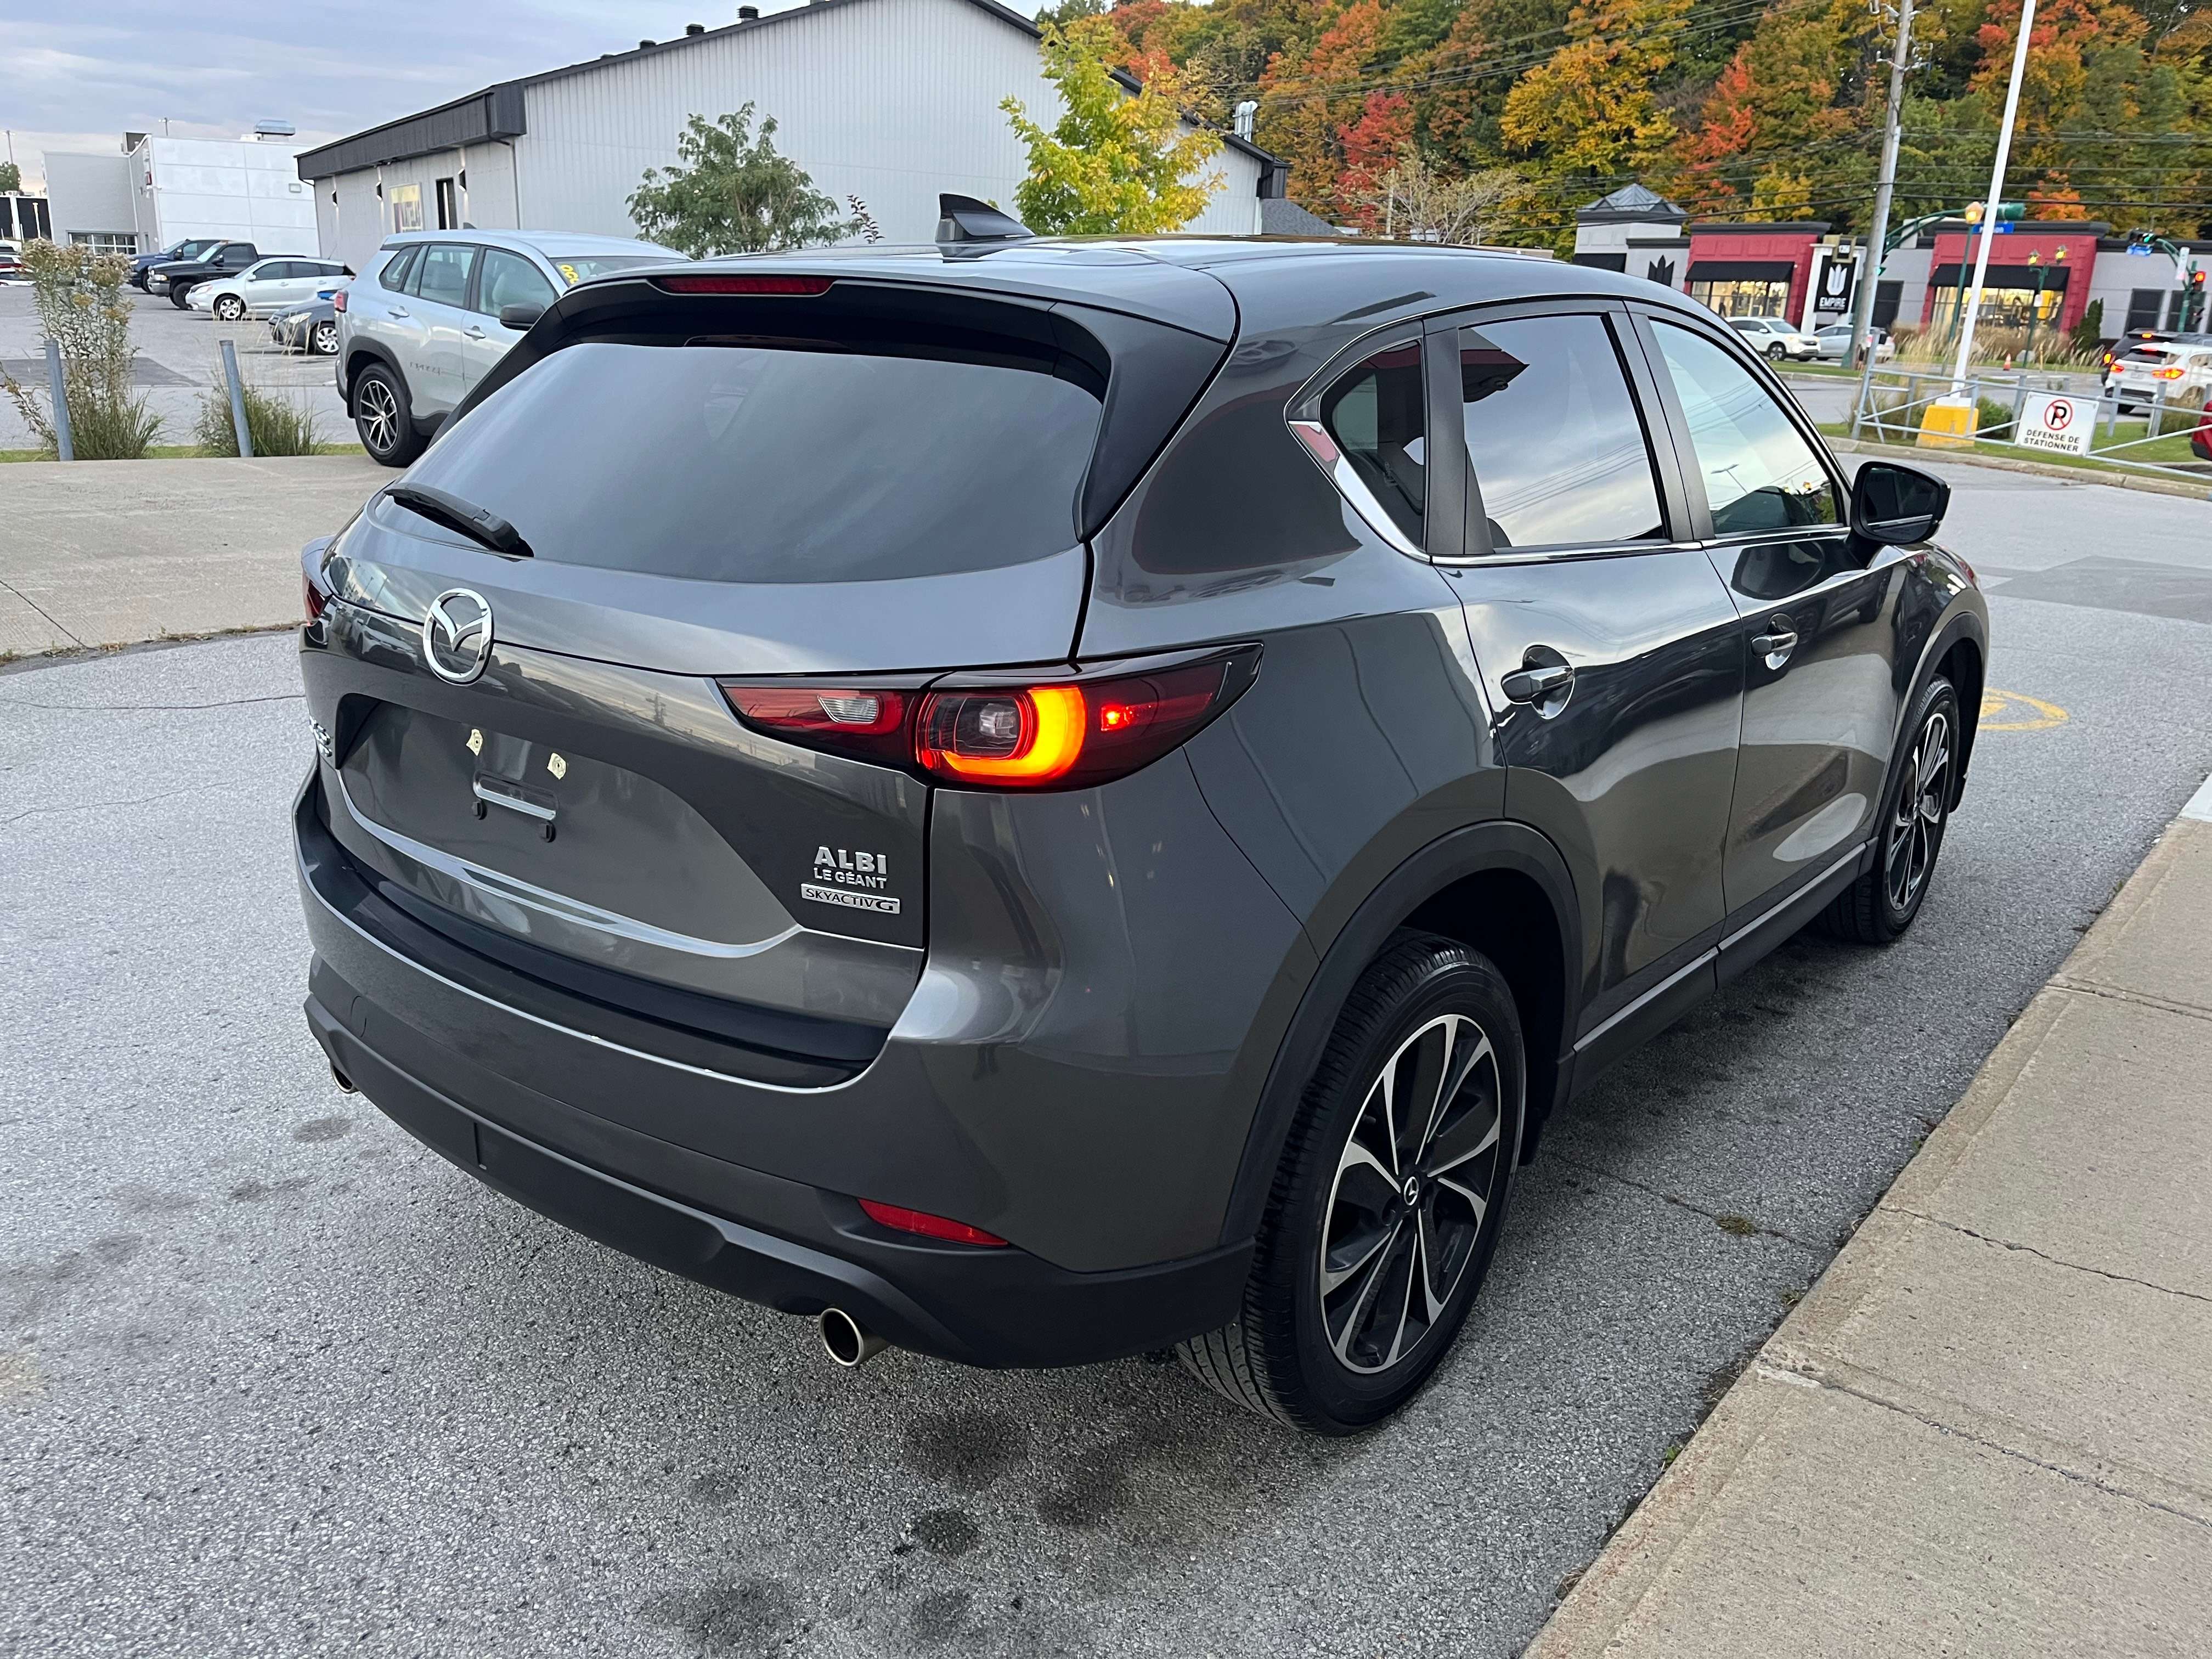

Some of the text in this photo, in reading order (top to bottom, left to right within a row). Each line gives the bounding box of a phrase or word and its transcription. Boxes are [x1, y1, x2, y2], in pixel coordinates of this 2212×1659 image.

[1819, 297, 1847, 307] EMPIRE
[2023, 437, 2079, 452] STATIONNER
[2068, 435, 2080, 444] DE
[814, 846, 887, 874] ALBI
[814, 867, 887, 889] LE GÉANT
